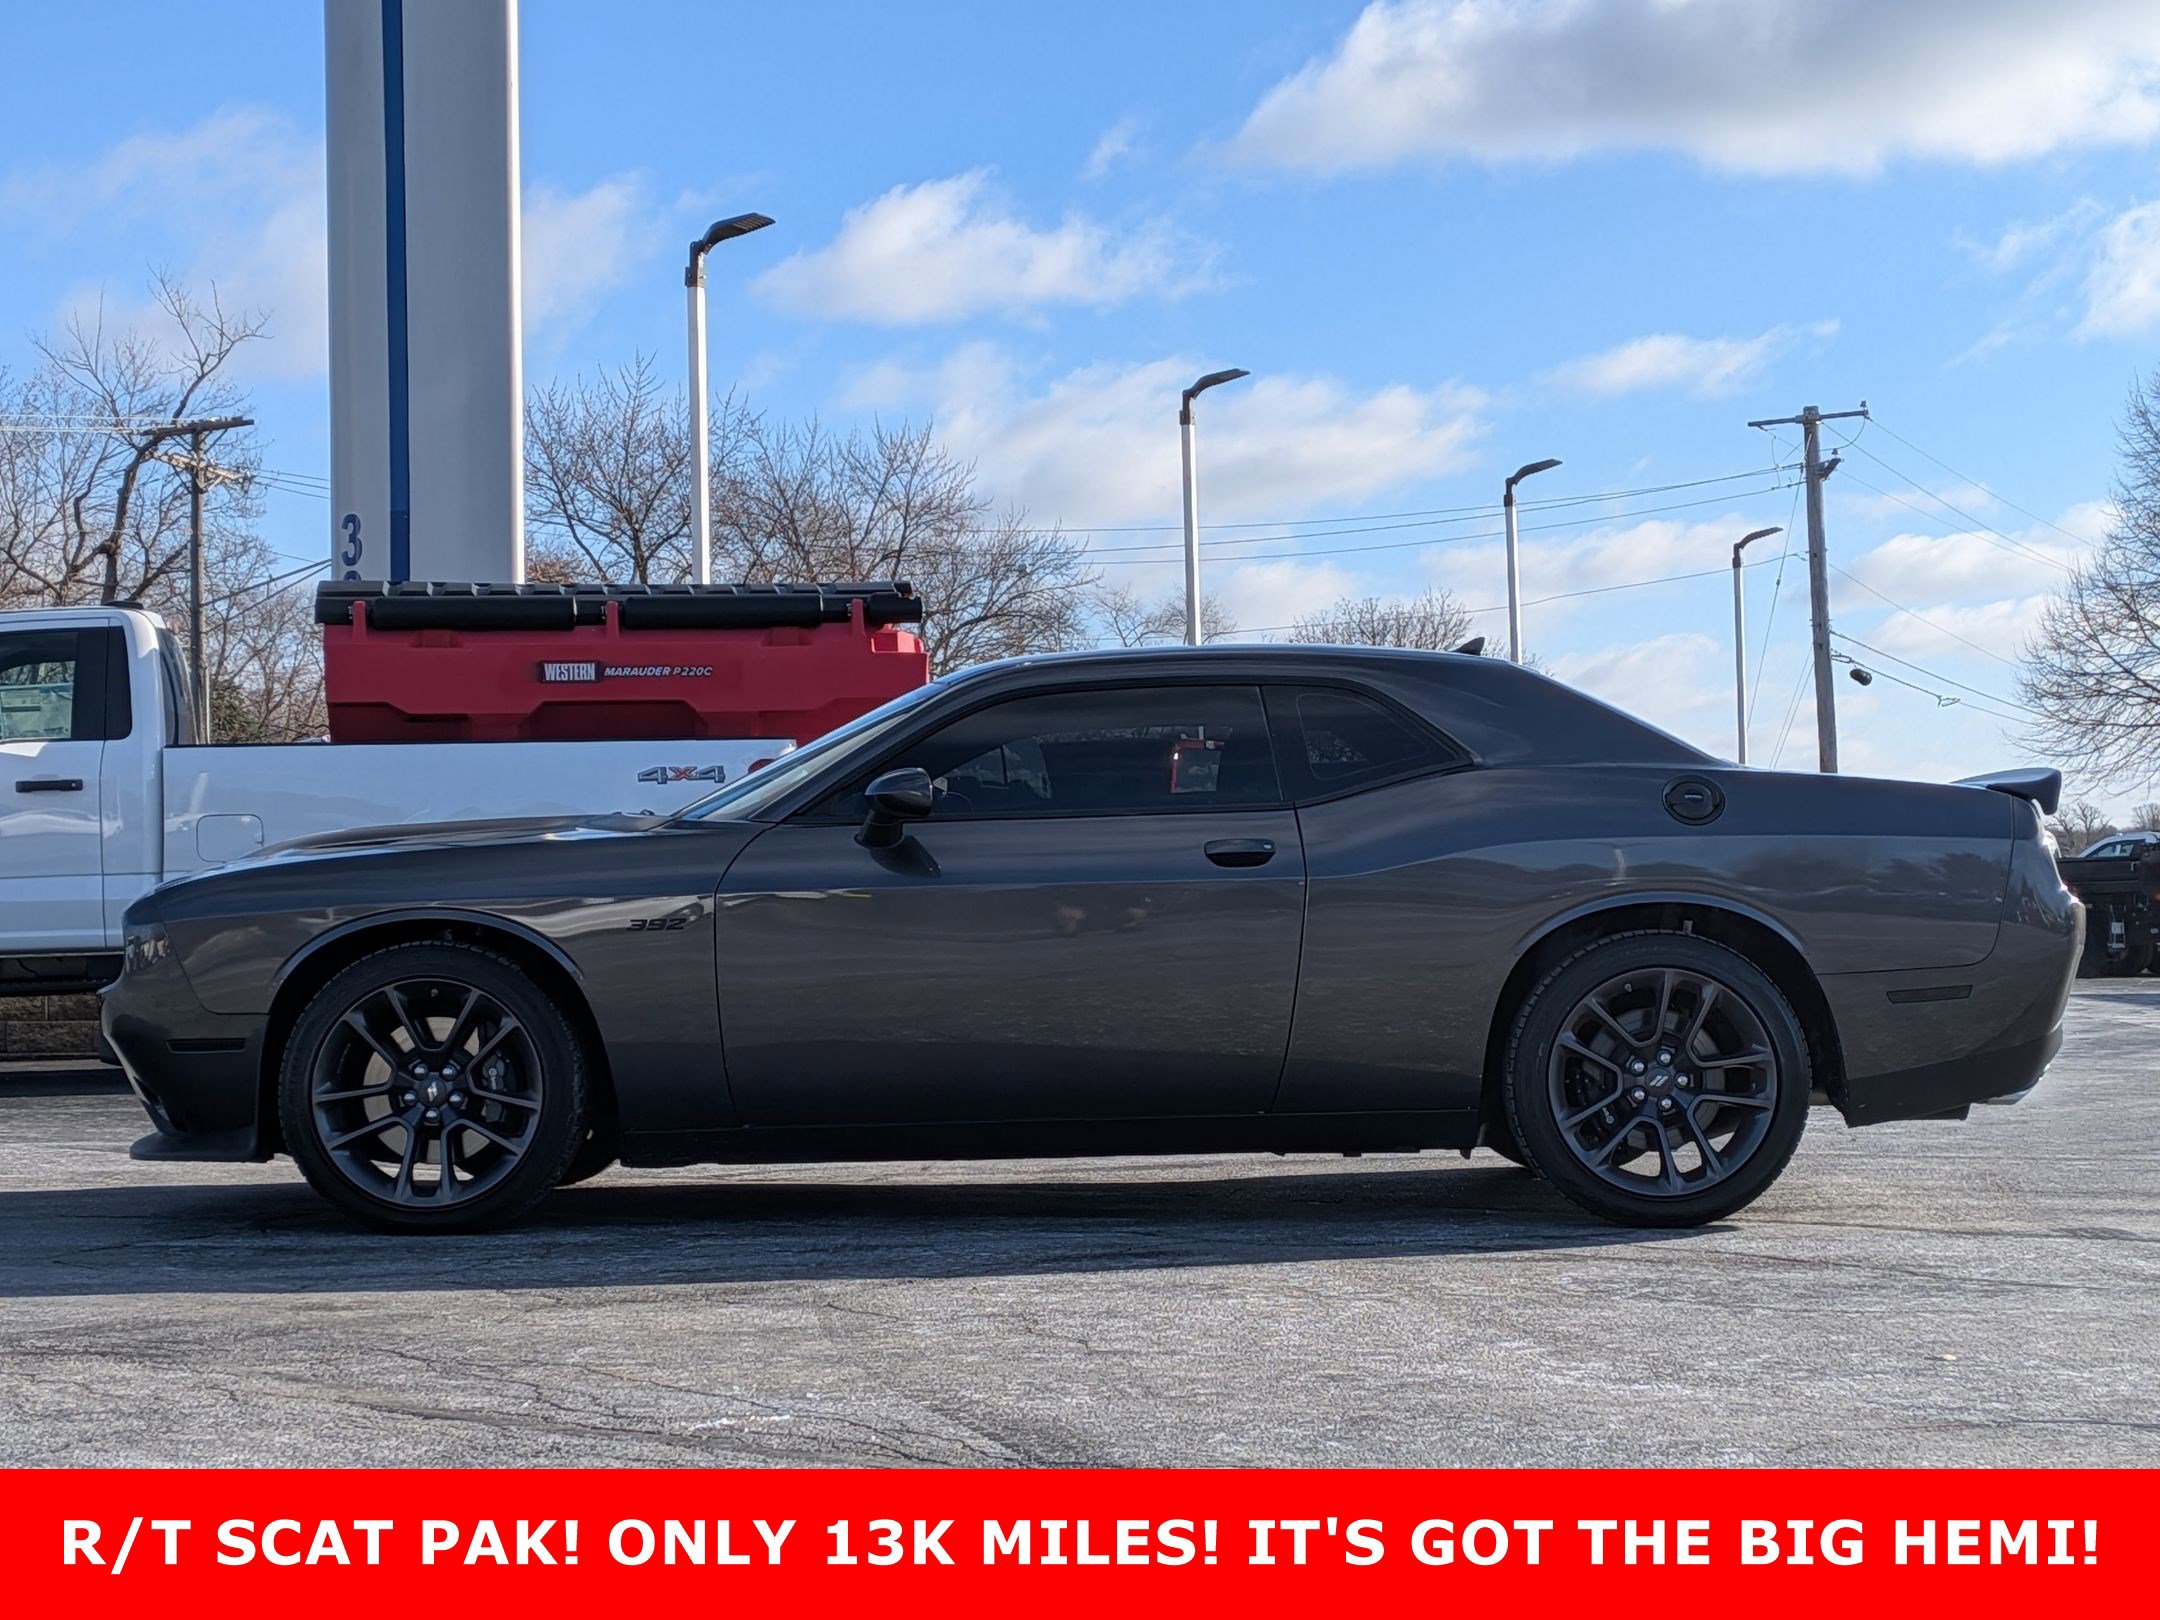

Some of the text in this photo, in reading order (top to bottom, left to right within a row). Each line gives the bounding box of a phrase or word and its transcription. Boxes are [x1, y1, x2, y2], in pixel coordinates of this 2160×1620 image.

[341, 513, 363, 581] 3
[544, 662, 713, 682] WESTERN MARAUDER P220C
[627, 918, 688, 931] 392
